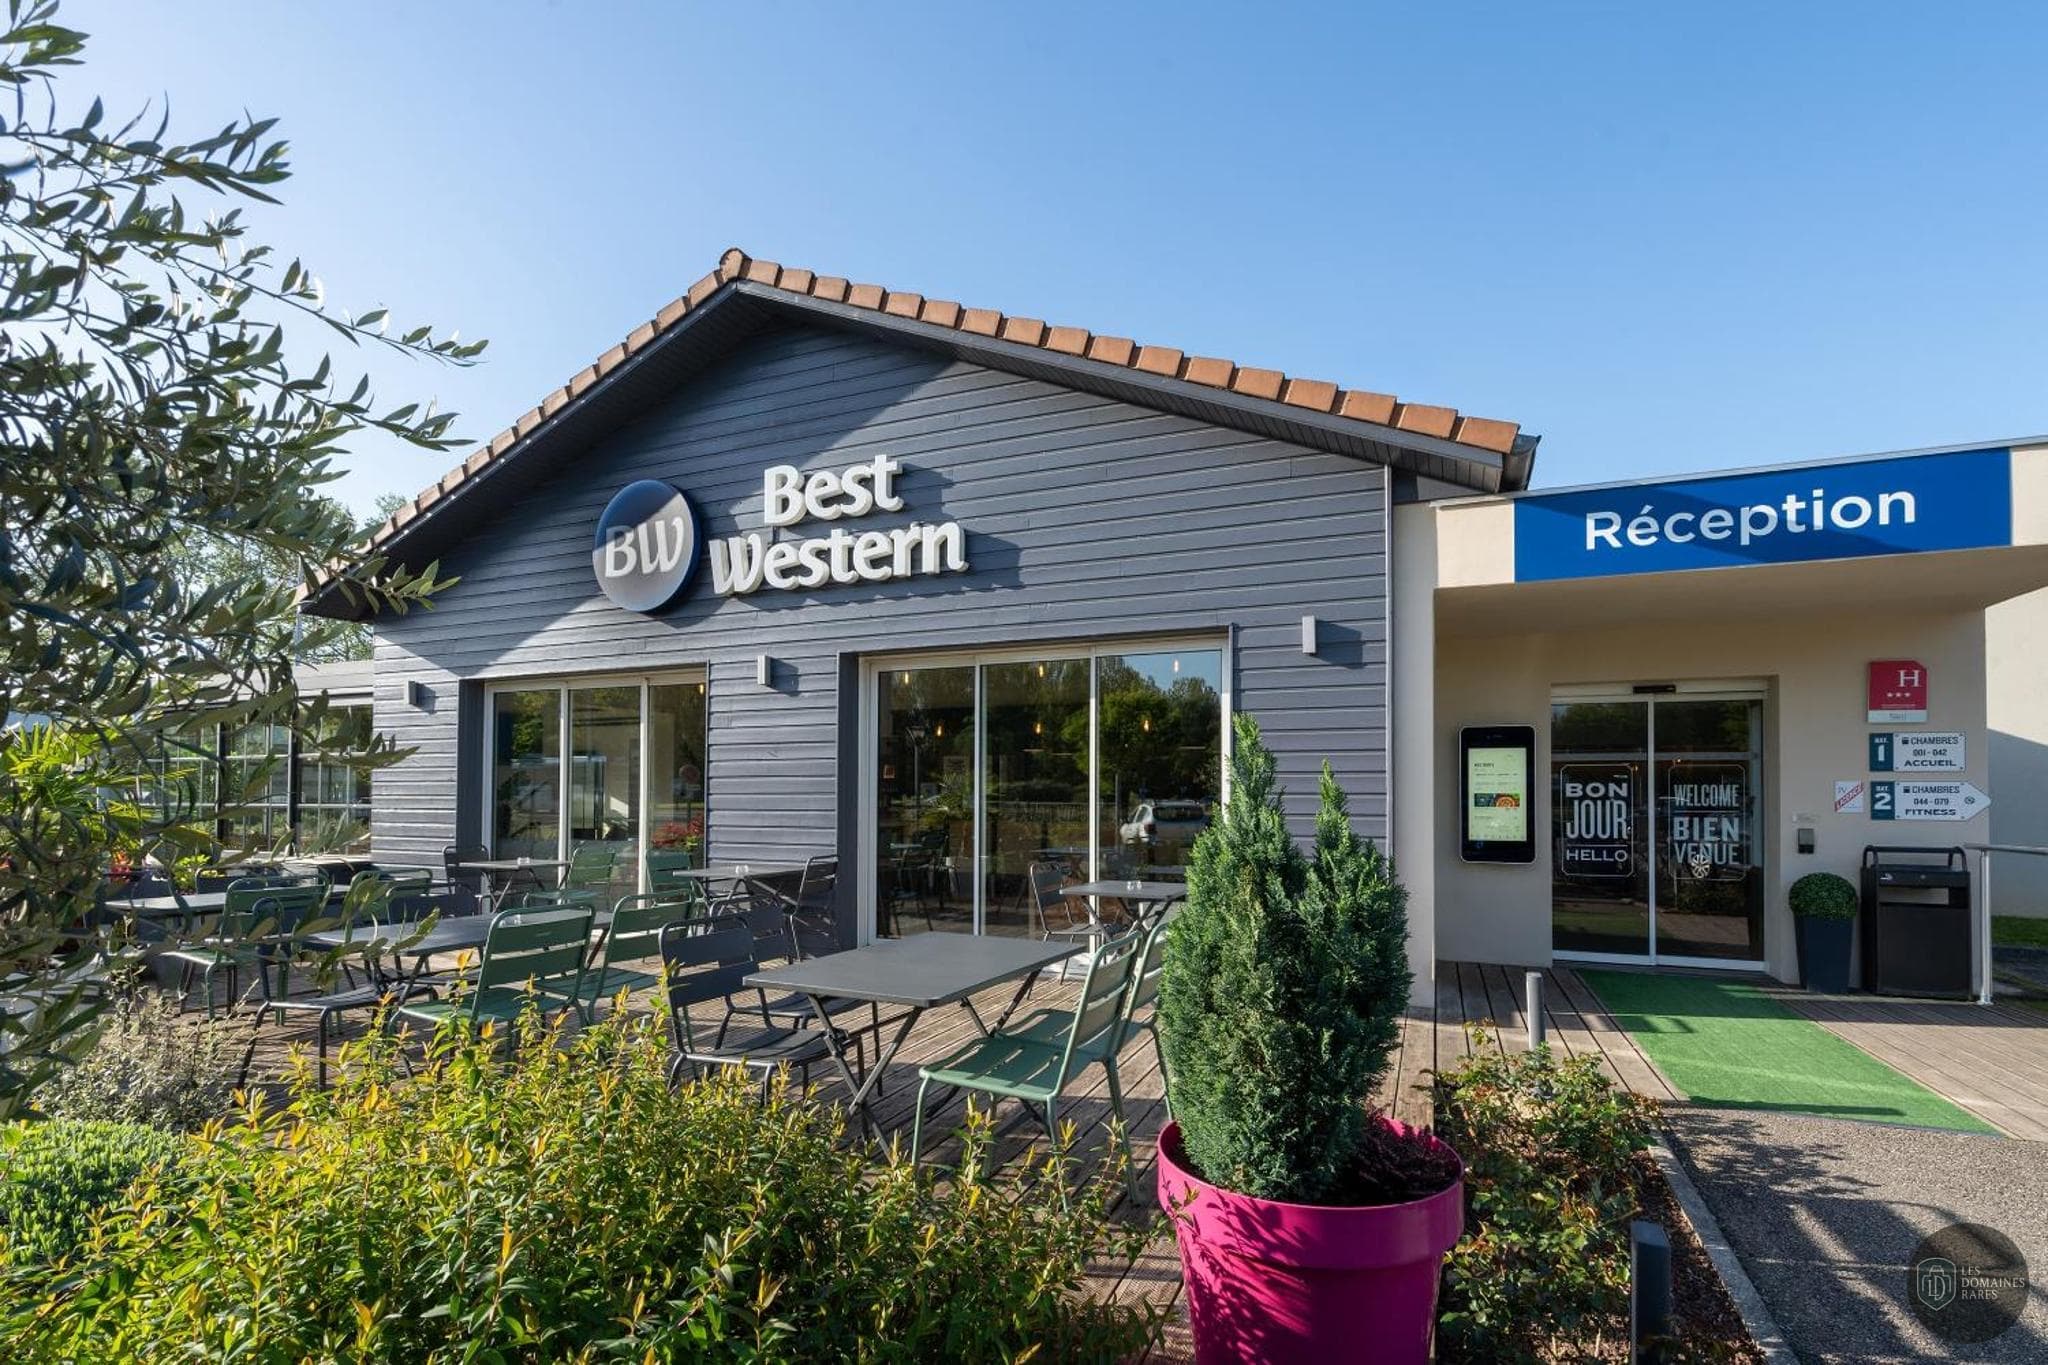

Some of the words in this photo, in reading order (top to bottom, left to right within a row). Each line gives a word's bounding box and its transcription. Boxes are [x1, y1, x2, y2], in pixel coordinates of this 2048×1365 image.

[764, 454, 904, 527] Best
[1585, 488, 1916, 550] Réception
[605, 516, 685, 578] BW
[708, 521, 970, 597] Western
[1898, 670, 1920, 688] H
[1911, 736, 1959, 745] CHAMBRES
[1878, 744, 1885, 762] 1
[1932, 749, 1948, 757] 042
[1566, 783, 1628, 798] BON
[1673, 784, 1740, 808] WELCOME
[1912, 786, 1960, 794] CHAMBRES
[1873, 792, 1892, 810] 2
[1566, 799, 1628, 840] JOUR
[1673, 817, 1740, 842] BIEN
[1566, 850, 1628, 862] HELLO
